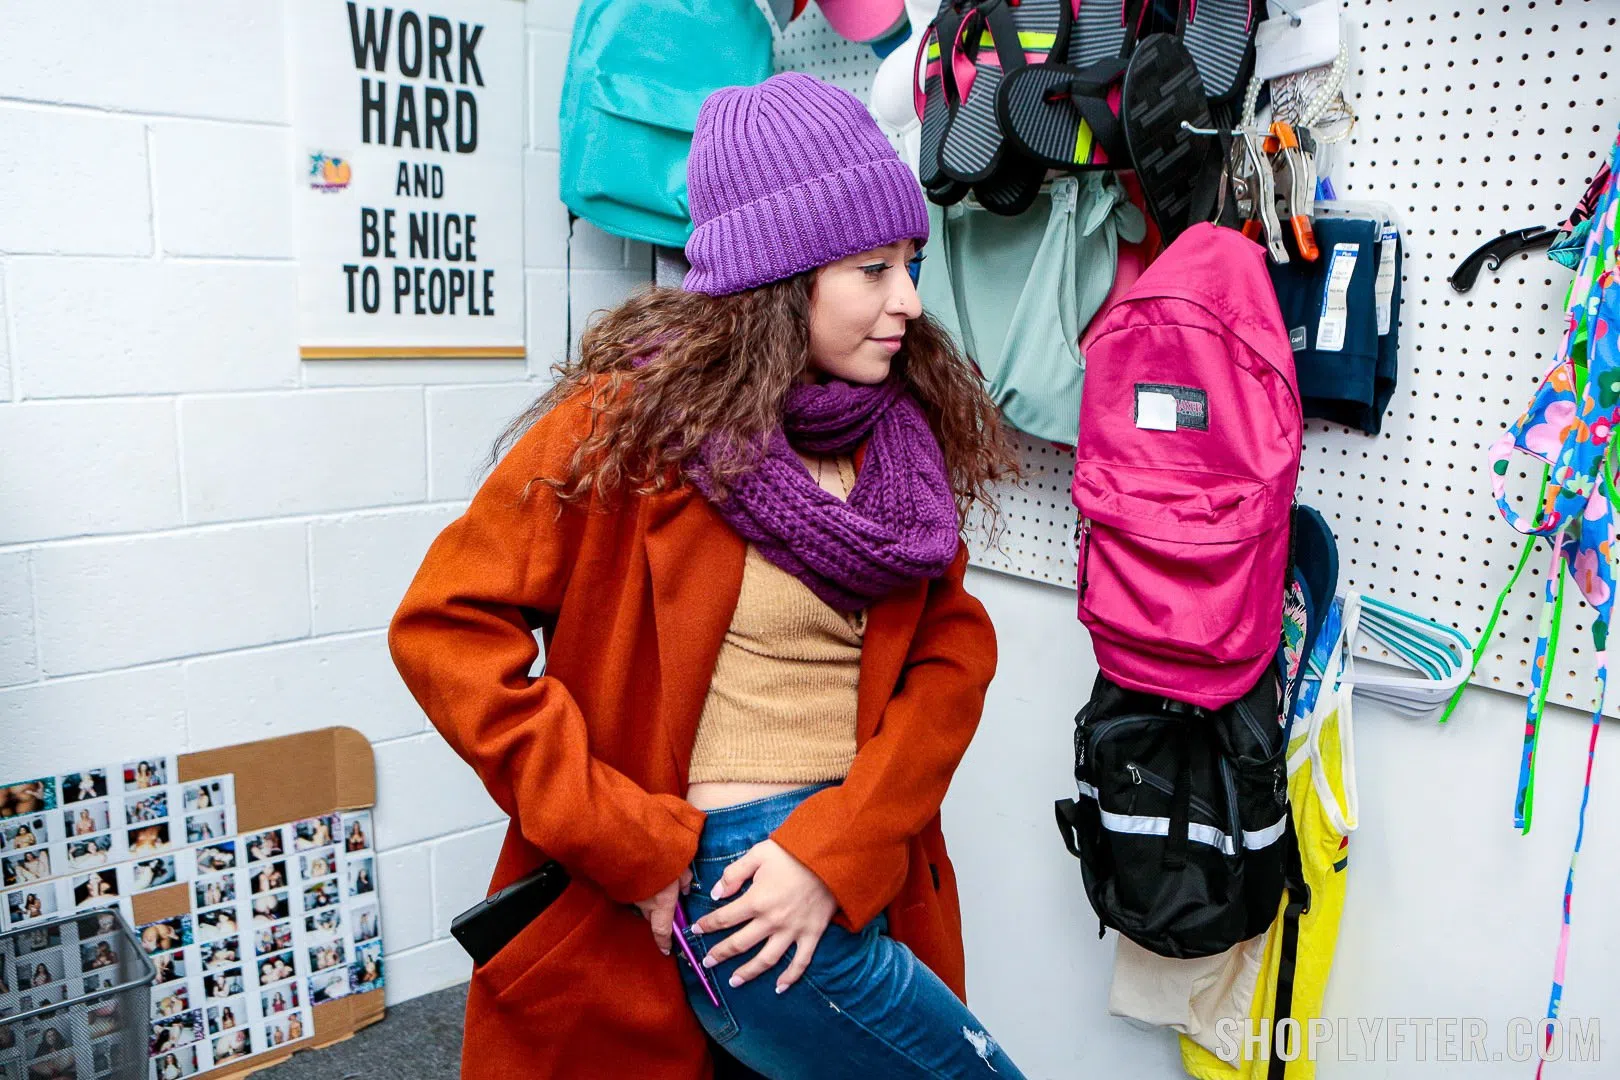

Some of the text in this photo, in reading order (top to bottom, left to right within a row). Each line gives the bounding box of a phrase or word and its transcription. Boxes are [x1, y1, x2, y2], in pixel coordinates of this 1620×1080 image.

[347, 2, 485, 87] WORK
[361, 78, 478, 153] HARD
[396, 161, 444, 199] AND
[361, 208, 477, 262] BE NICE
[343, 265, 495, 316] TO PEOPLE
